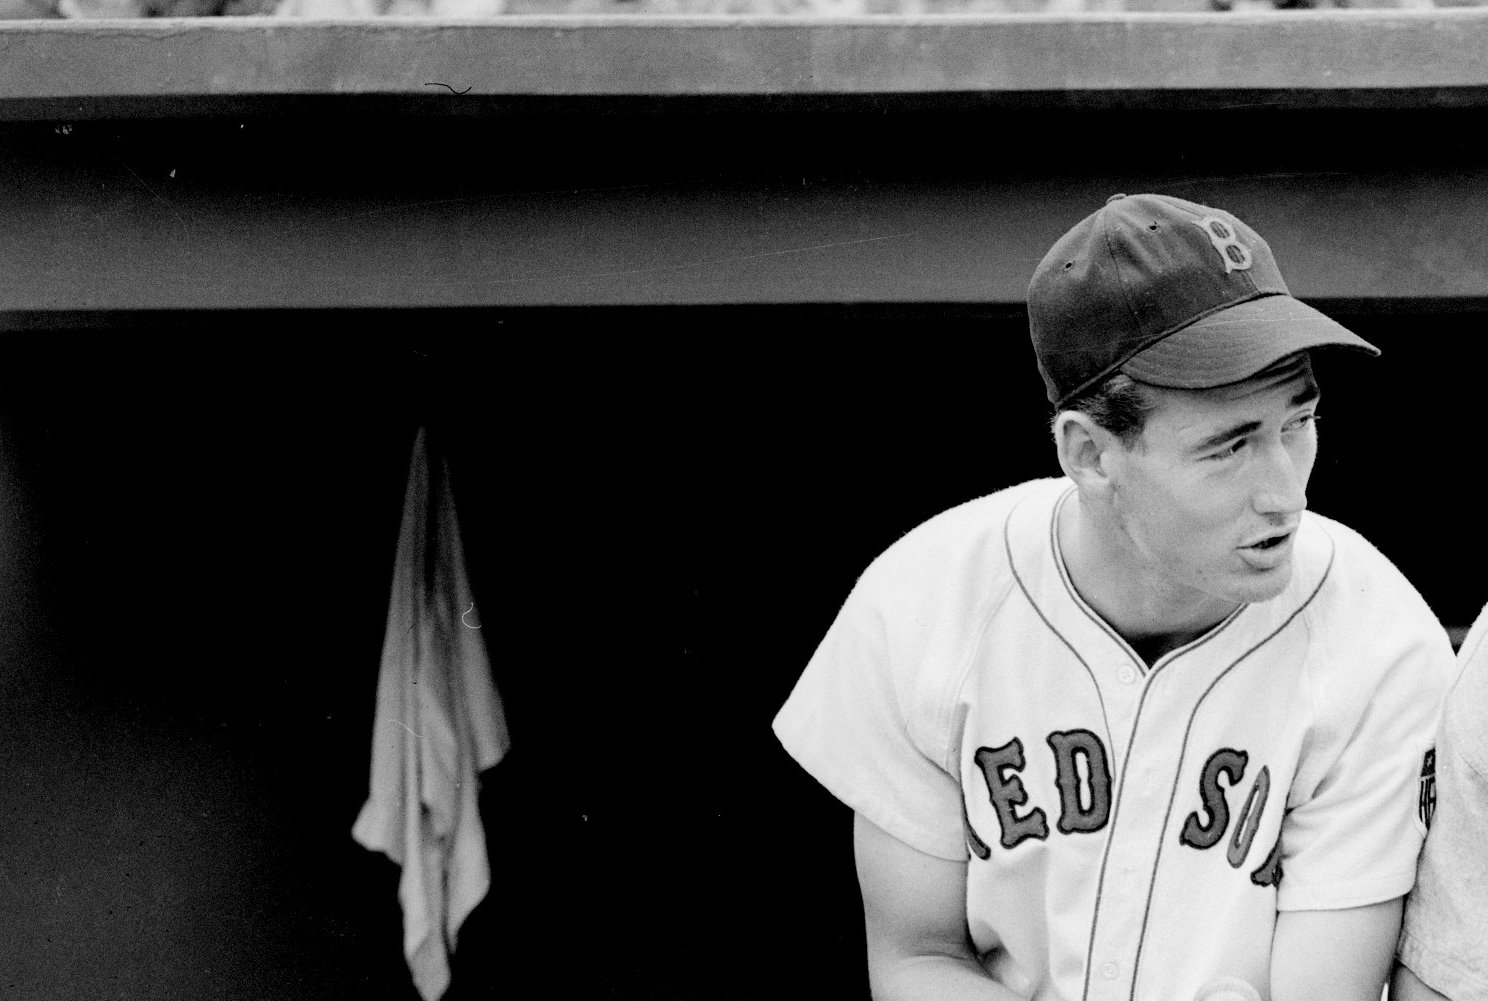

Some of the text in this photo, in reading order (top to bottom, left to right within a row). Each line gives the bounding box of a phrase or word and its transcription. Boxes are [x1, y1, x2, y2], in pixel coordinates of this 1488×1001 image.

[1191, 216, 1252, 274] B
[964, 728, 1284, 887] ED SO
